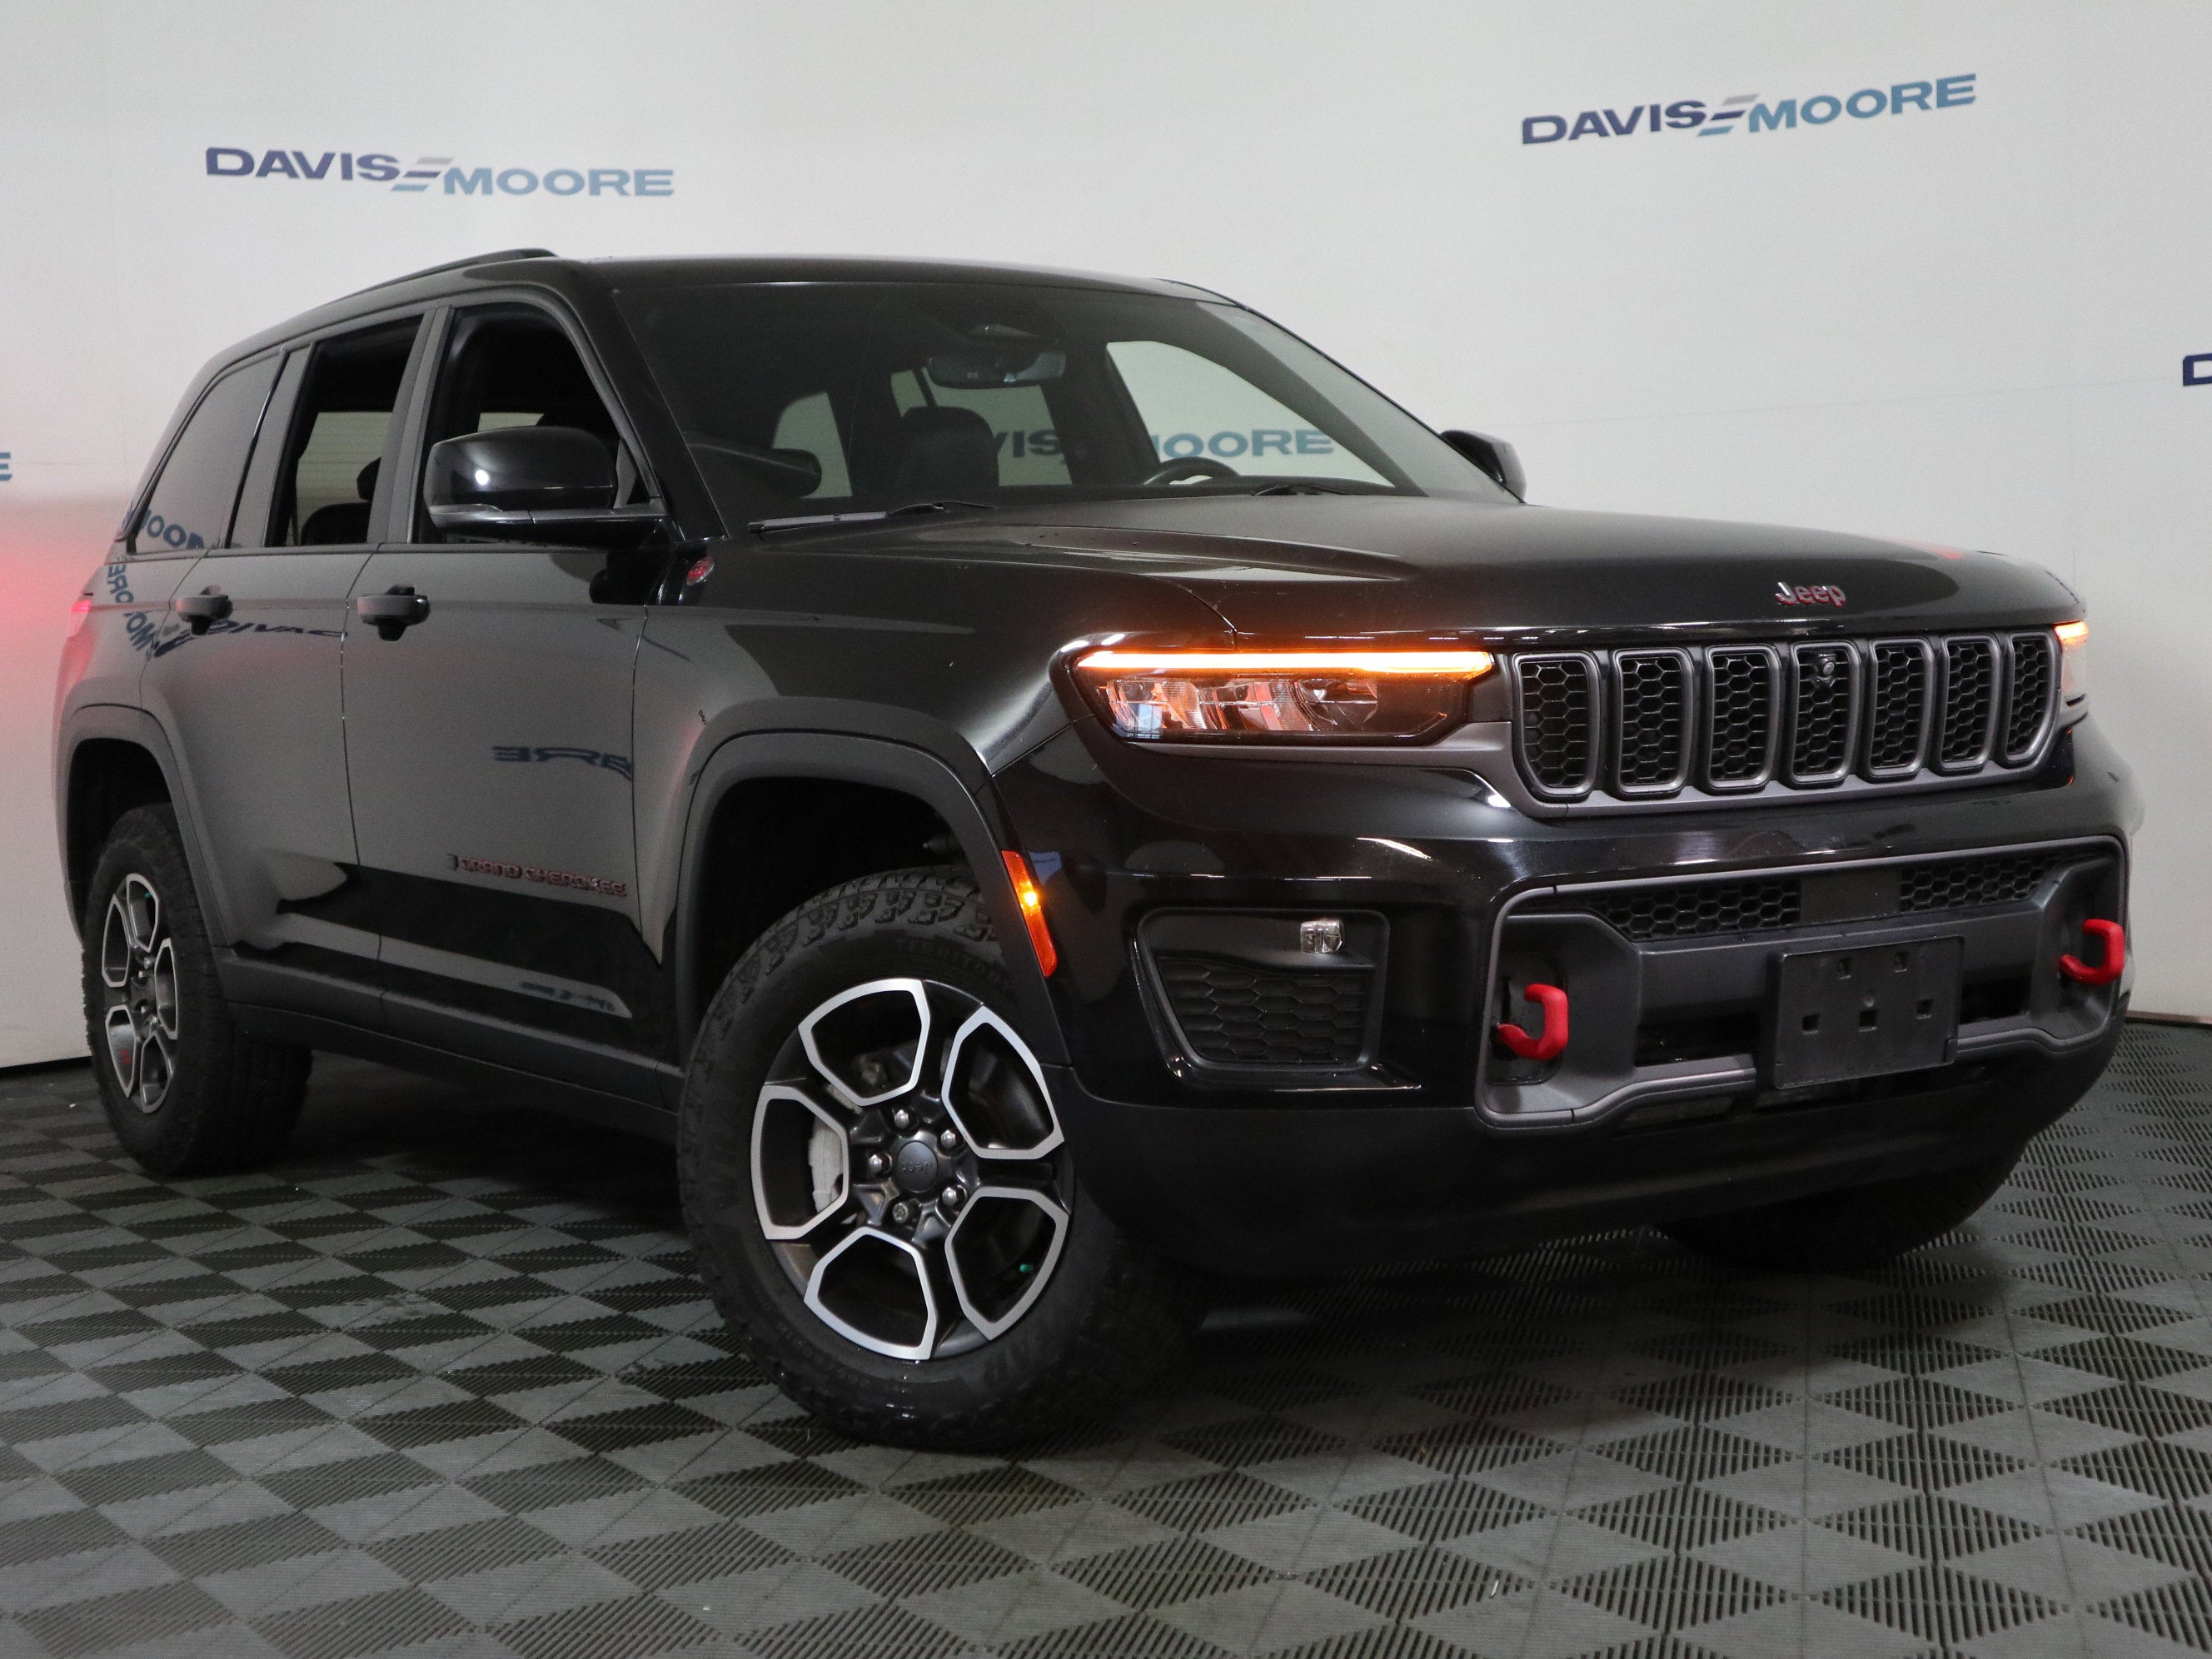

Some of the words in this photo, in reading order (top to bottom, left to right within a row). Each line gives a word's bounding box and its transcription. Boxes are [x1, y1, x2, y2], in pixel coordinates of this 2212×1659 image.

[1522, 100, 1706, 145] DAVIS
[1749, 72, 1977, 133] MOORE
[206, 147, 400, 182] DAVIS
[443, 167, 675, 197] MOORE
[1151, 428, 1334, 459] OORE
[1775, 581, 1846, 608] Jeep
